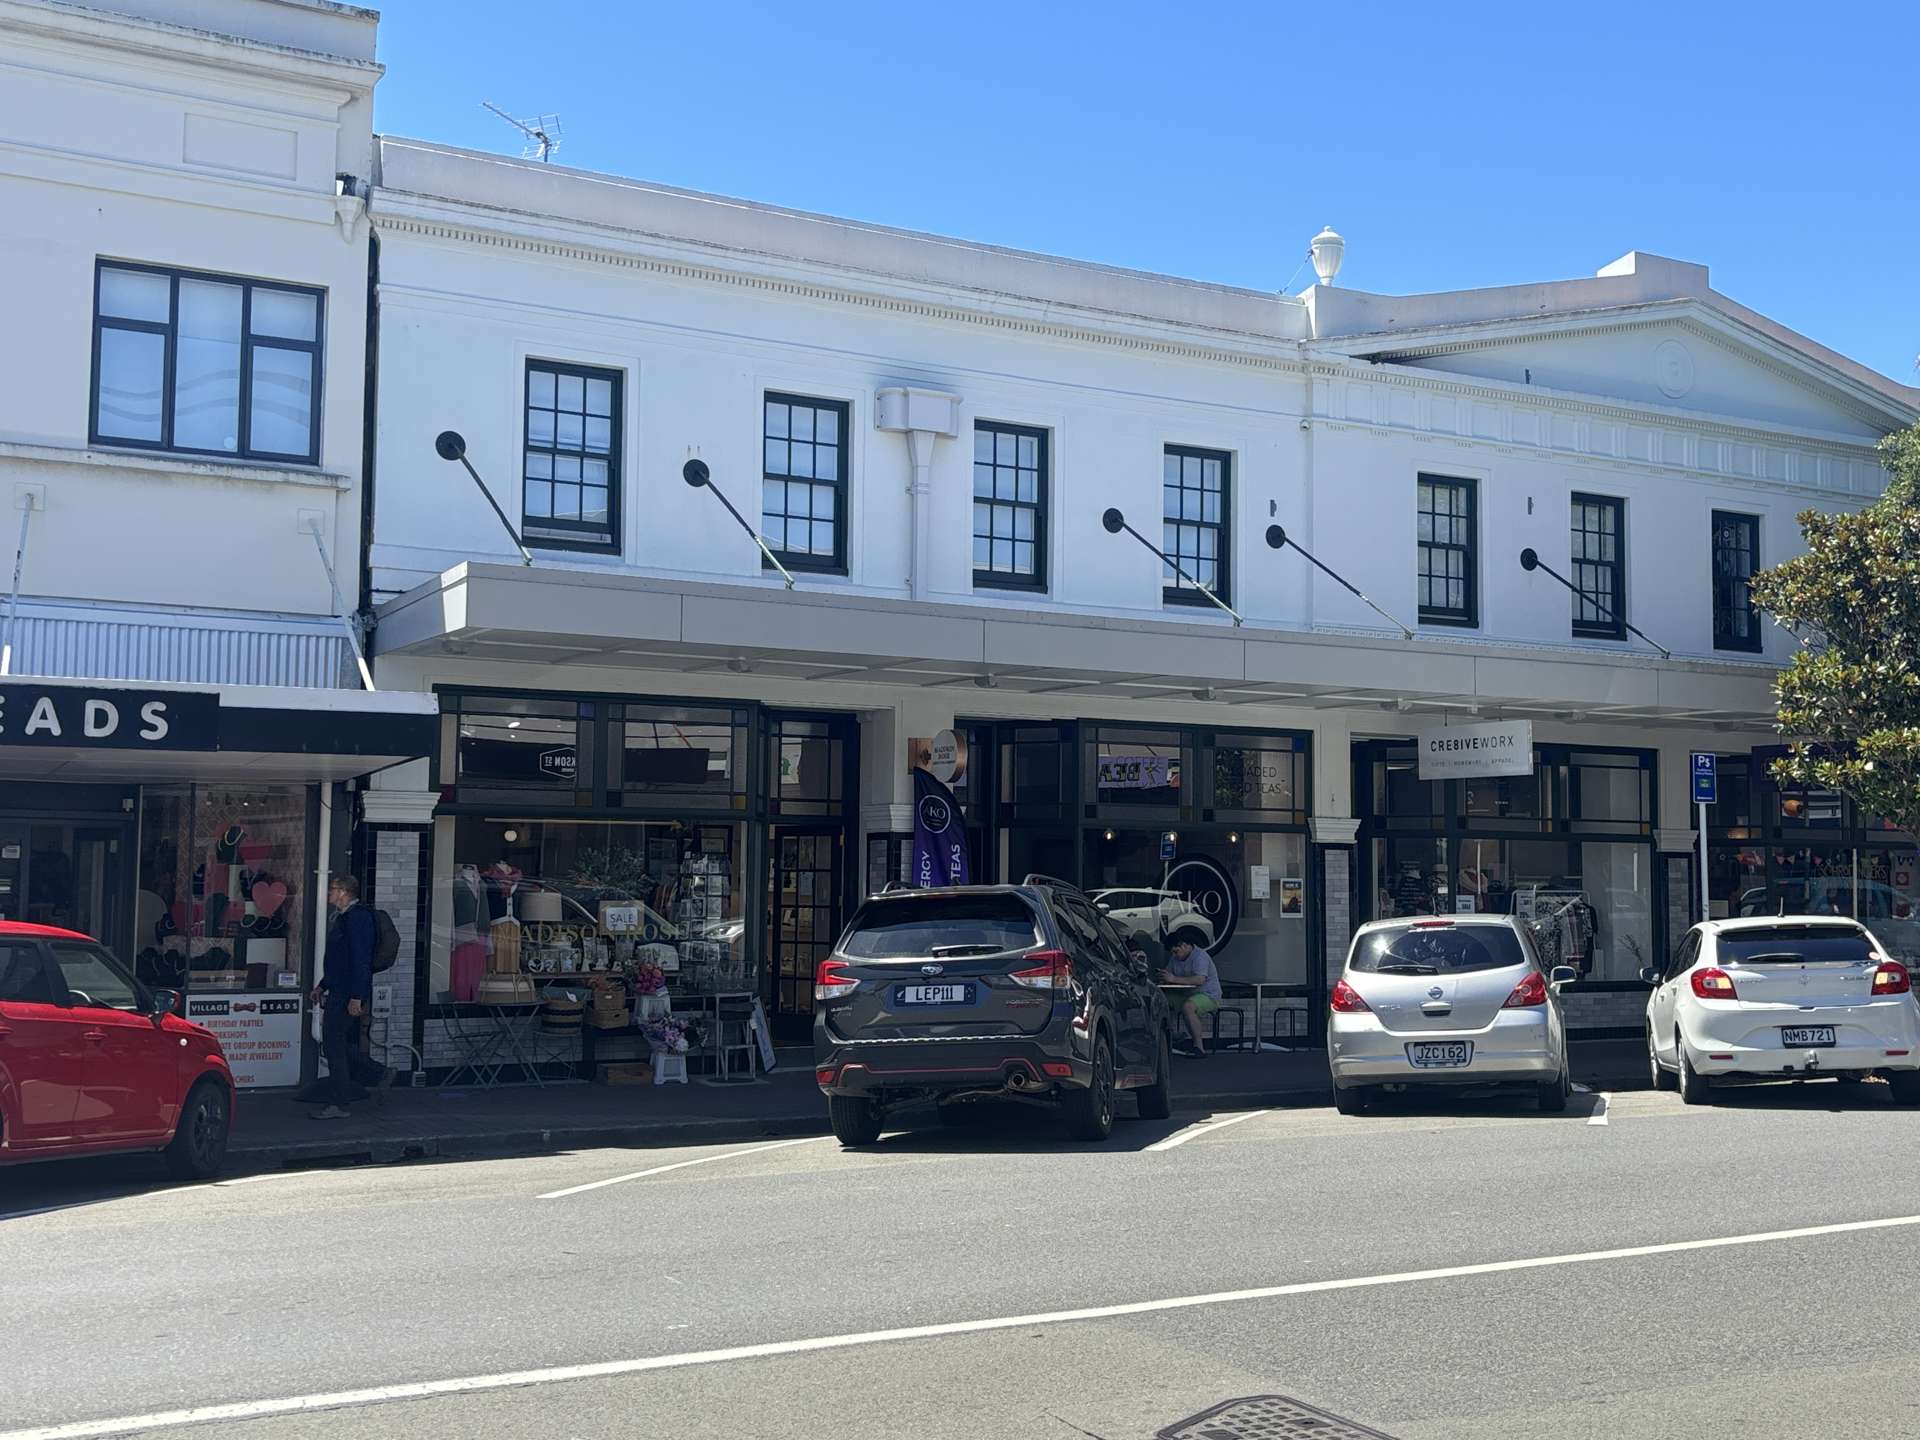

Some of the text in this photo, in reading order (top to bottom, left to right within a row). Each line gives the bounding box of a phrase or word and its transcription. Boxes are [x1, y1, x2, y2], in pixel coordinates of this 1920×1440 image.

[0, 696, 169, 740] ADS
[1430, 735, 1514, 752] CRE8IVEWORX
[950, 844, 961, 880] TEAS
[920, 851, 931, 888] ERGY
[609, 913, 635, 923] SALE
[191, 1003, 228, 1012] VILLAGE
[239, 1019, 264, 1028] PARTIES
[1784, 1027, 1831, 1042] NMB721
[257, 1040, 291, 1049] BOOKINGS
[1417, 1046, 1464, 1059] JZC162
